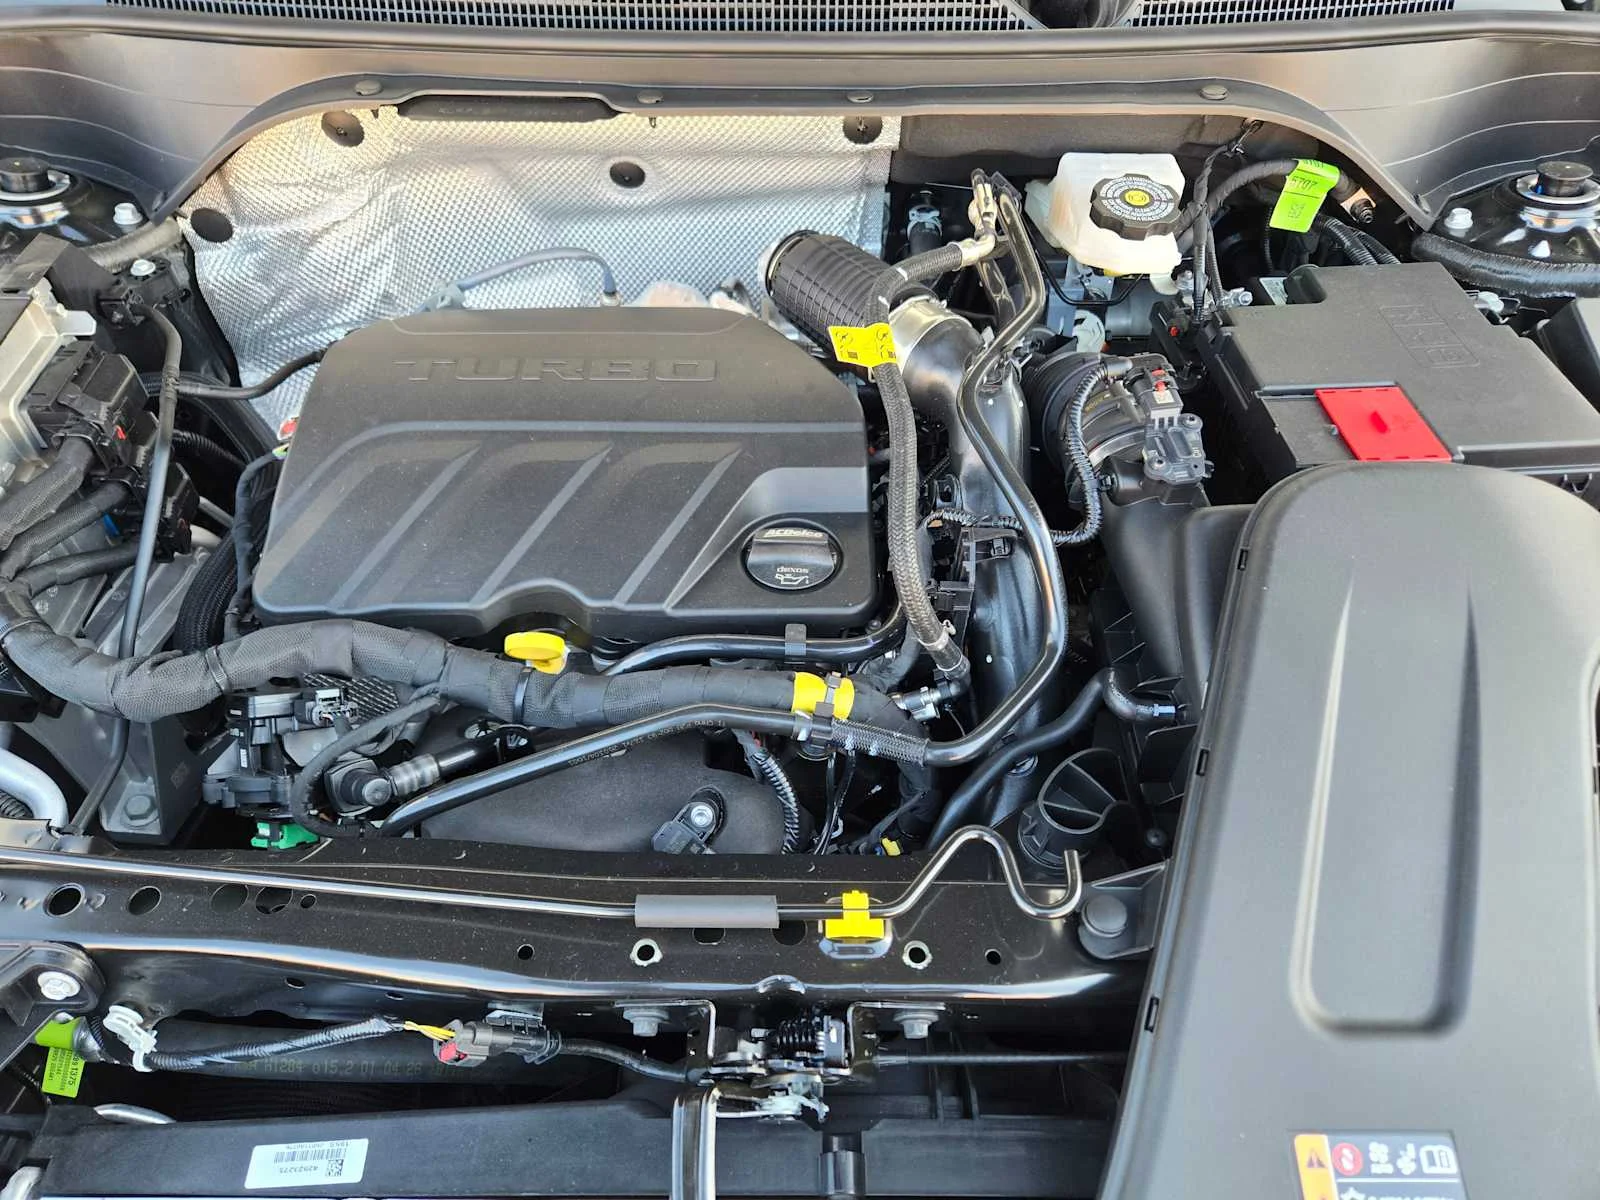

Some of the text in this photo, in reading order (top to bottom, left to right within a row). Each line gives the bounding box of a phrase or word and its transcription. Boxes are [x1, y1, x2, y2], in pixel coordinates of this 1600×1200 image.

[392, 358, 718, 382] TURBO
[763, 528, 824, 538] ACDelco
[777, 565, 809, 574] dexos
